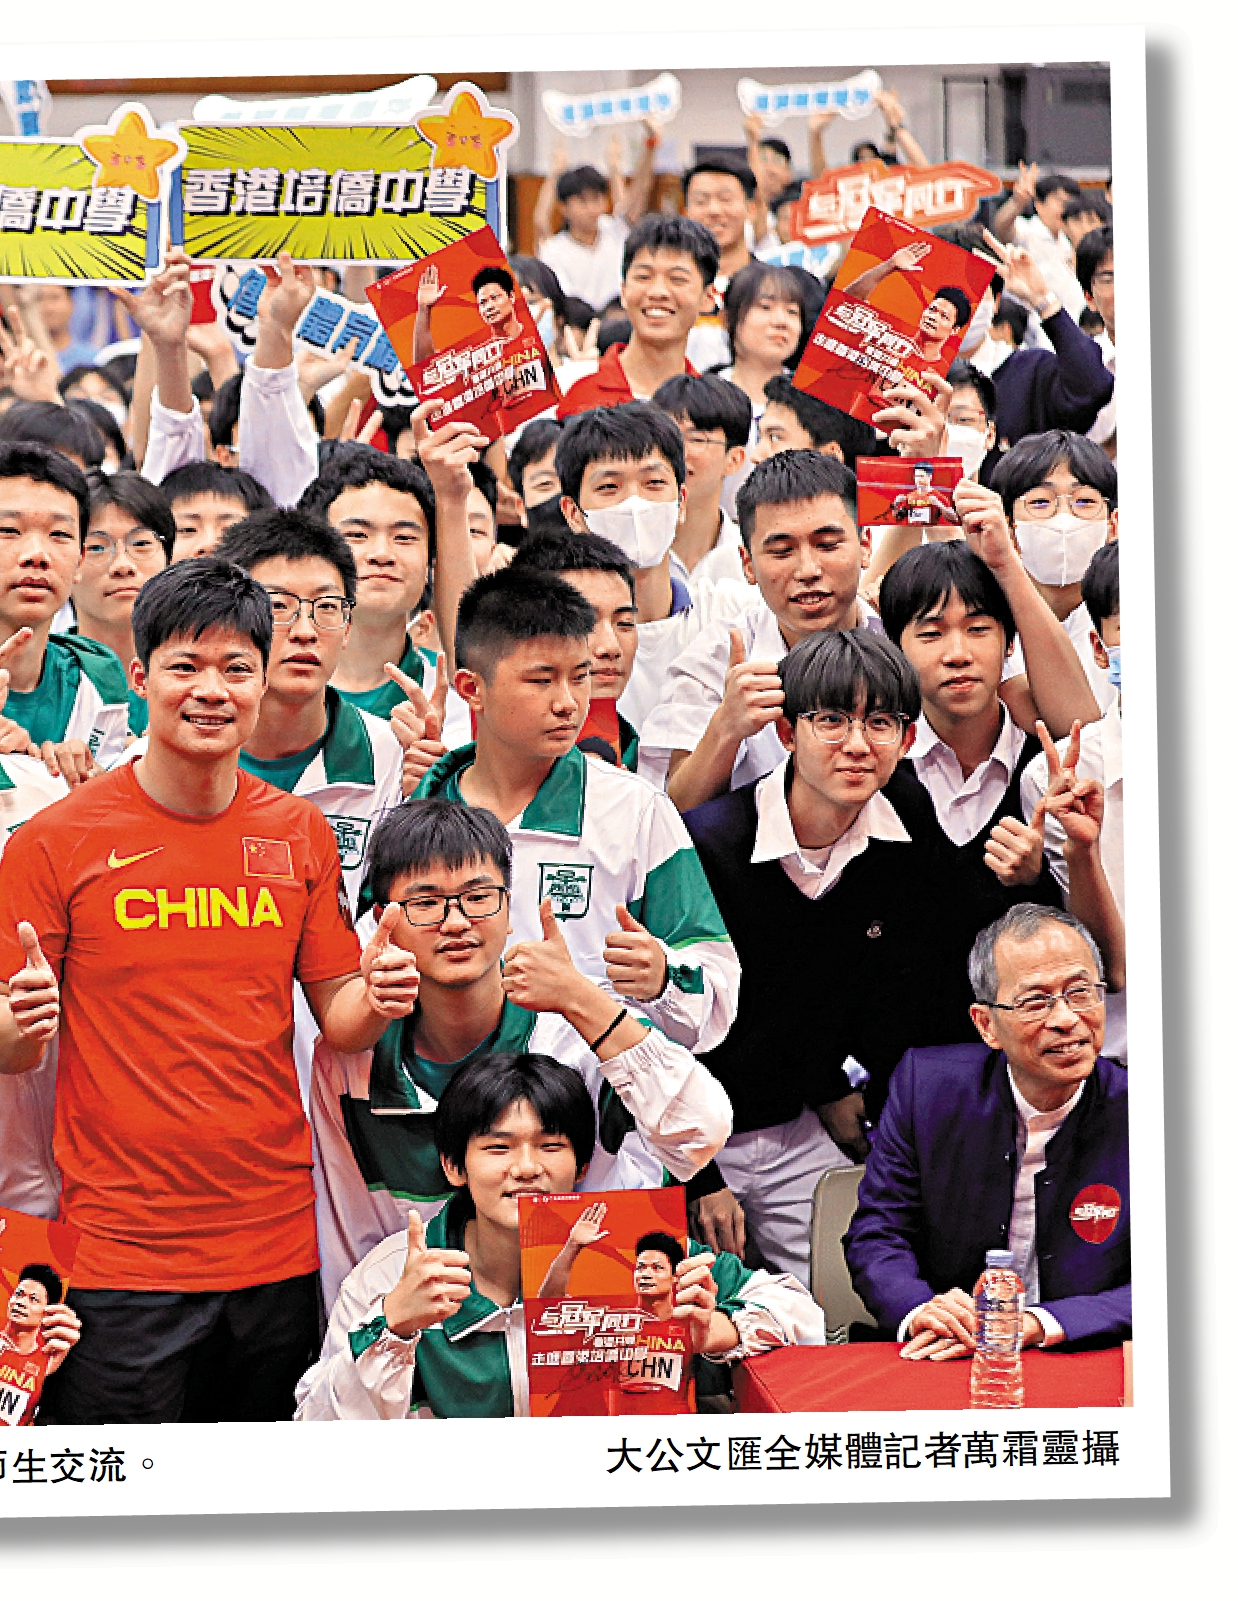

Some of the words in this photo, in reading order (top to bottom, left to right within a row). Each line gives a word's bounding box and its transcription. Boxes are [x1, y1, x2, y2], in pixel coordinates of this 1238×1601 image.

[184, 167, 471, 214] 香港培僑中學
[114, 886, 284, 930] CHINA
